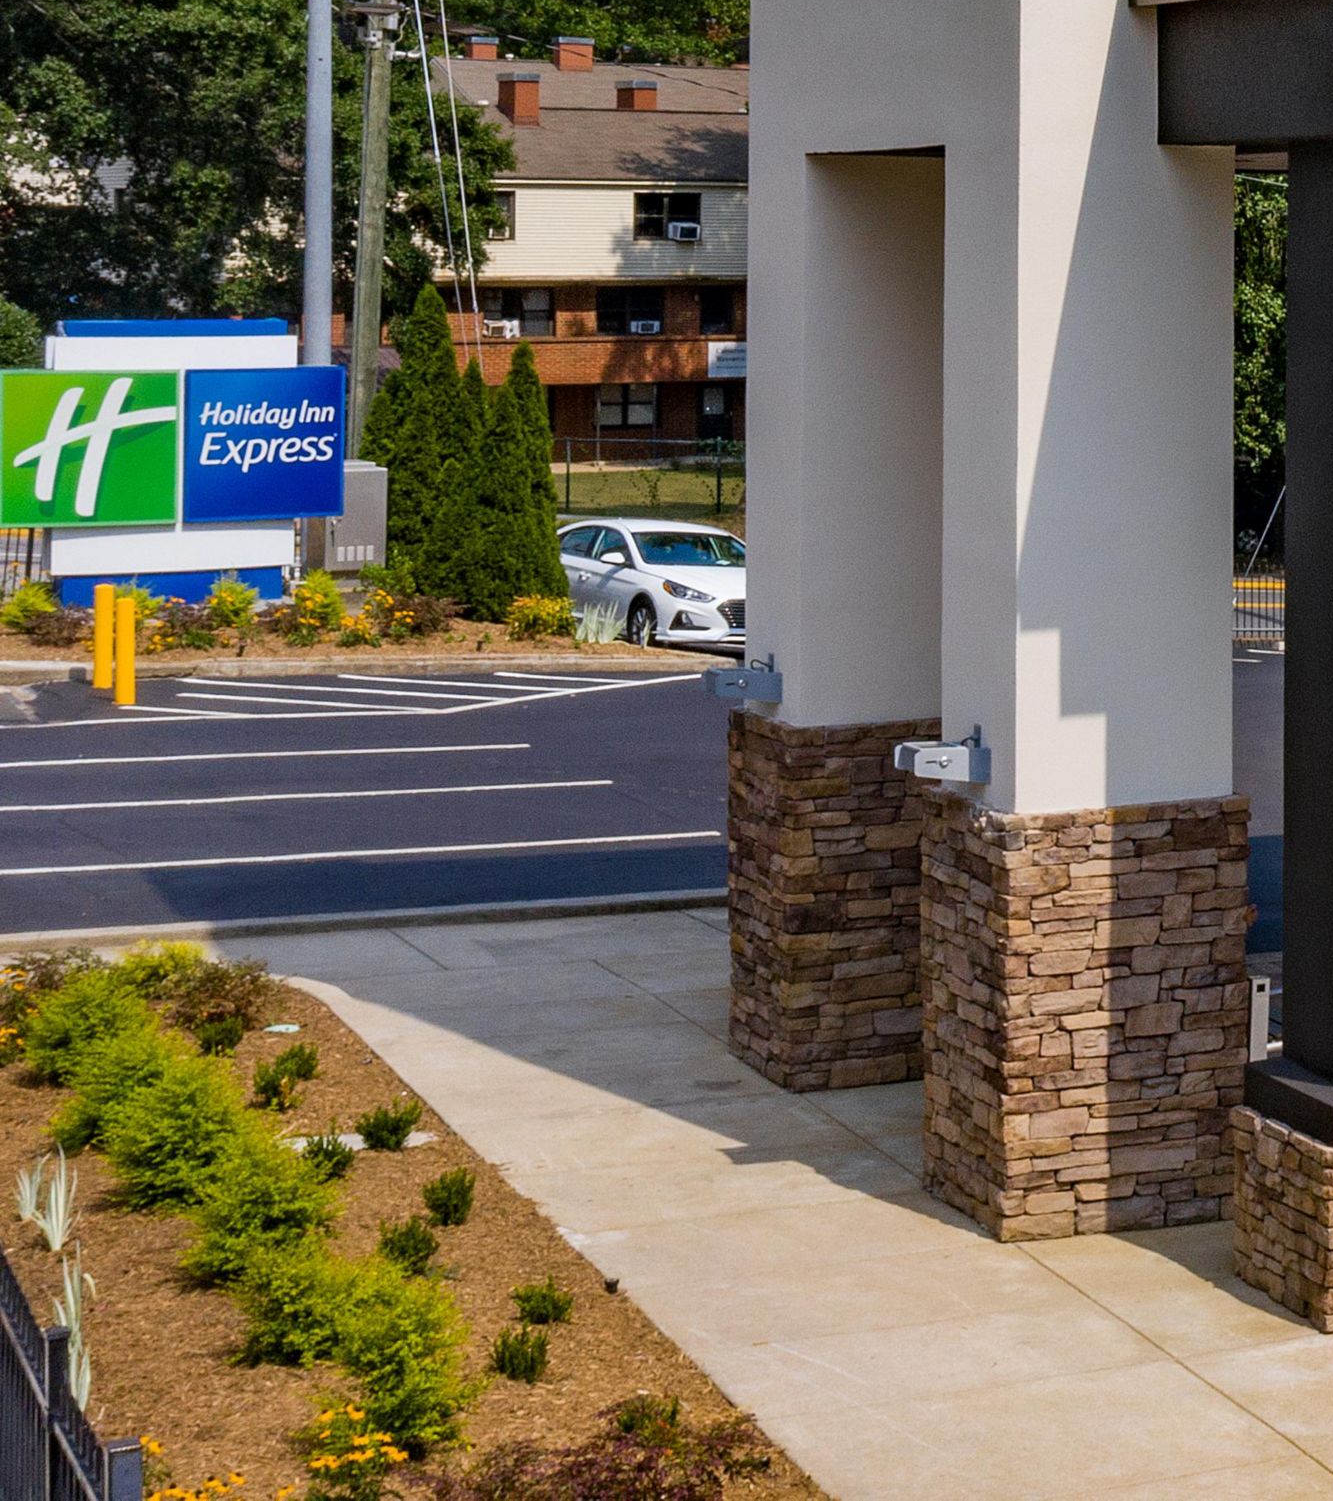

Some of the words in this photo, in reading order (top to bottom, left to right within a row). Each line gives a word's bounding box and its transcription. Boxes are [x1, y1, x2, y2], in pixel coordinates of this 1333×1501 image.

[198, 401, 297, 430] Holiday
[298, 399, 336, 423] Inn
[199, 431, 335, 474] Express
